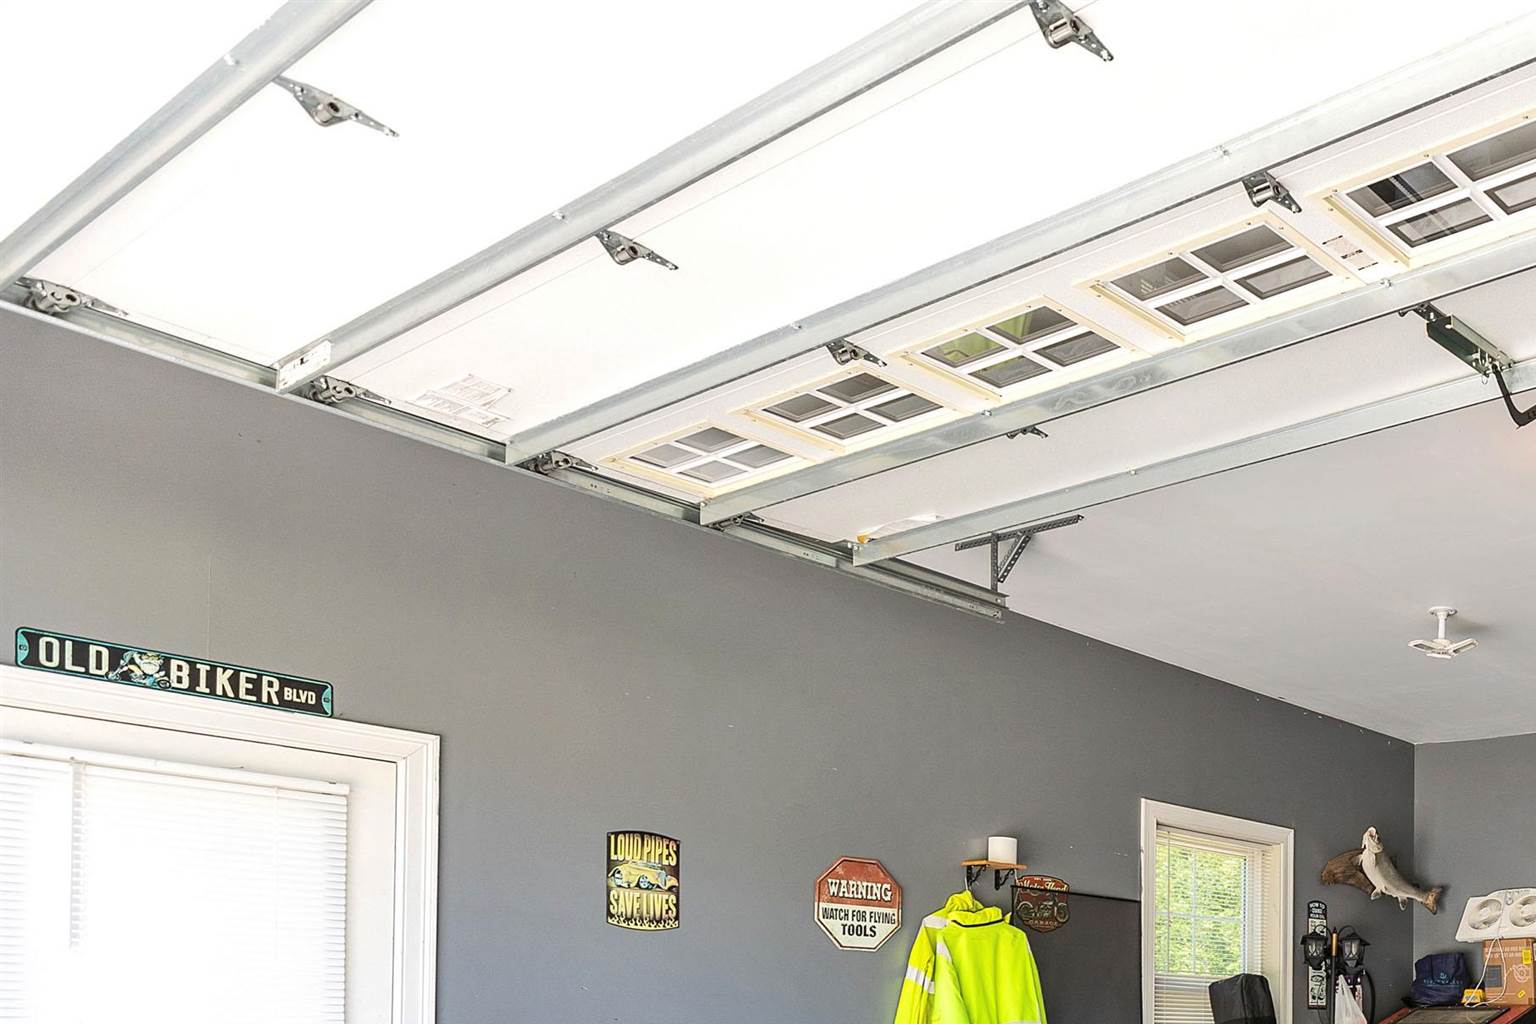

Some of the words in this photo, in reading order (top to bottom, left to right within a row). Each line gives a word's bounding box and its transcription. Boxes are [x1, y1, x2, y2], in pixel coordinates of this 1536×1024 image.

[38, 636, 109, 675] OLD
[170, 659, 280, 705] BIKER
[284, 686, 316, 705] BLVD
[610, 834, 641, 860] LOUD
[643, 834, 677, 866] PIPES
[827, 879, 892, 902] WARNING
[609, 889, 640, 917] SAVE
[643, 892, 677, 919] LIVES
[821, 907, 849, 921] WATCH
[851, 910, 867, 922] FOR
[869, 910, 896, 925] FLYING
[841, 924, 877, 938] TOOLS
